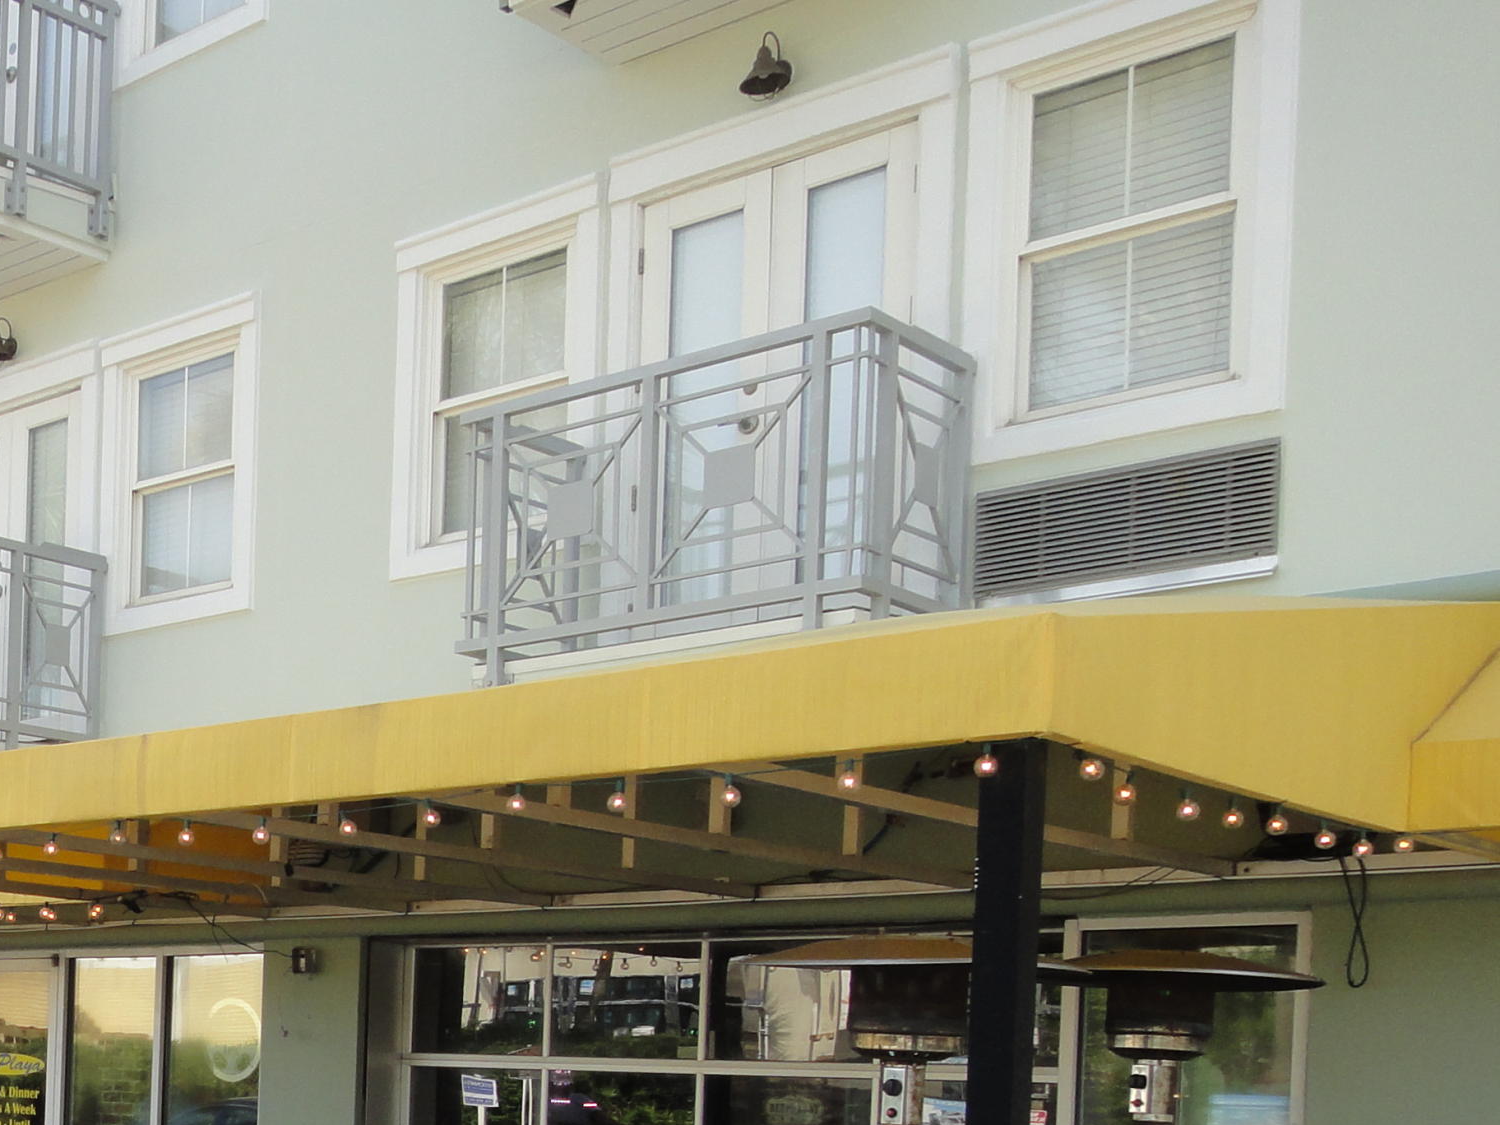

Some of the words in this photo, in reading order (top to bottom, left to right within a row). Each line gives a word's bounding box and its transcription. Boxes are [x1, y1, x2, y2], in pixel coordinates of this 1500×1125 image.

[0, 1086, 6, 1098] &
[9, 1086, 40, 1099] Dinner
[4, 1102, 11, 1114] A
[12, 1103, 36, 1115] Week
